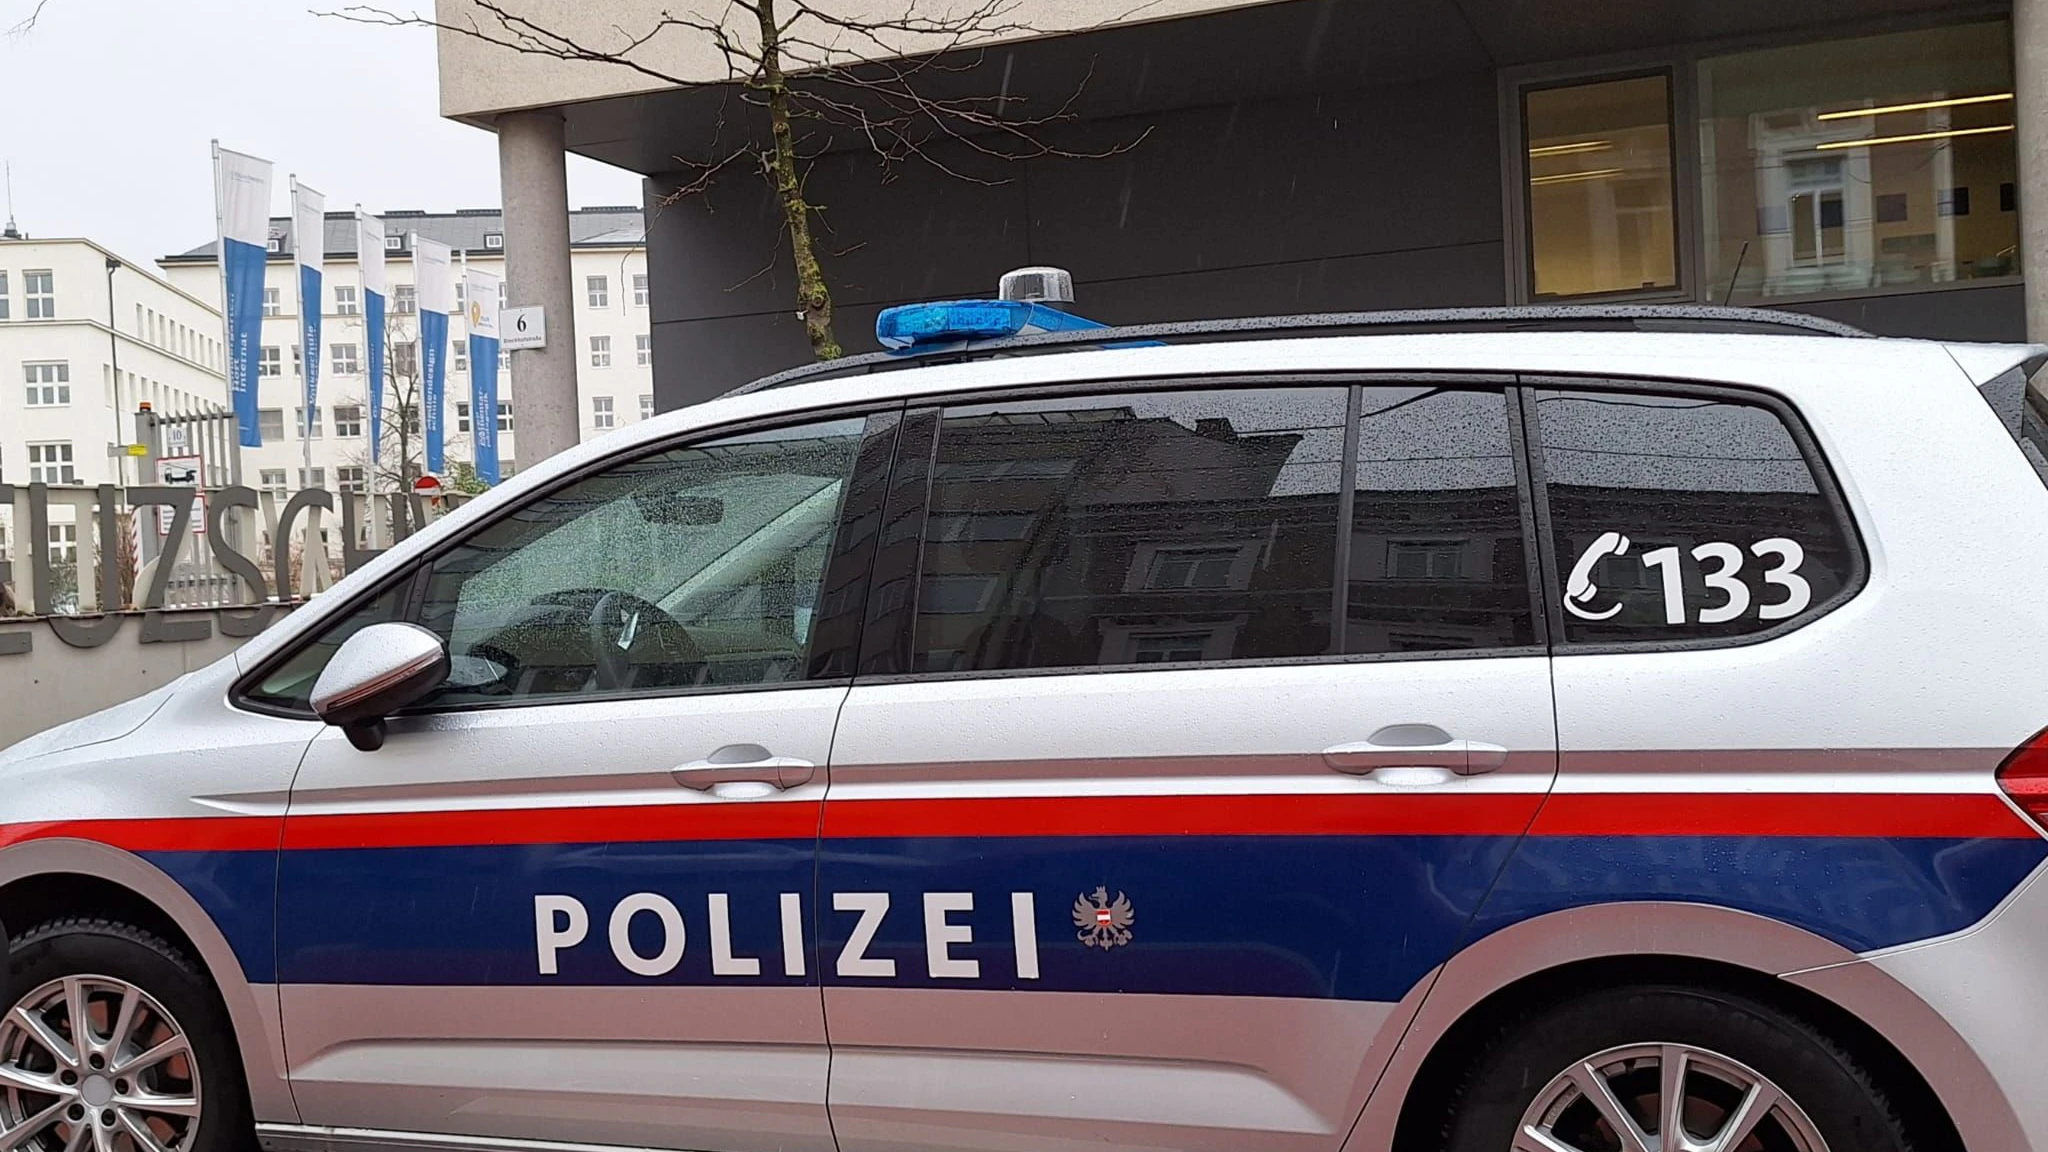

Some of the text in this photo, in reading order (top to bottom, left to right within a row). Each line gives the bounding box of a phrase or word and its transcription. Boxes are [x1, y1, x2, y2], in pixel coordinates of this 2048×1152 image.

[517, 313, 527, 332] 6
[231, 358, 240, 392] Hort
[240, 331, 248, 393] Internat
[172, 429, 183, 441] 10
[1642, 537, 1811, 625] 133
[534, 892, 1040, 979] POLIZEI
